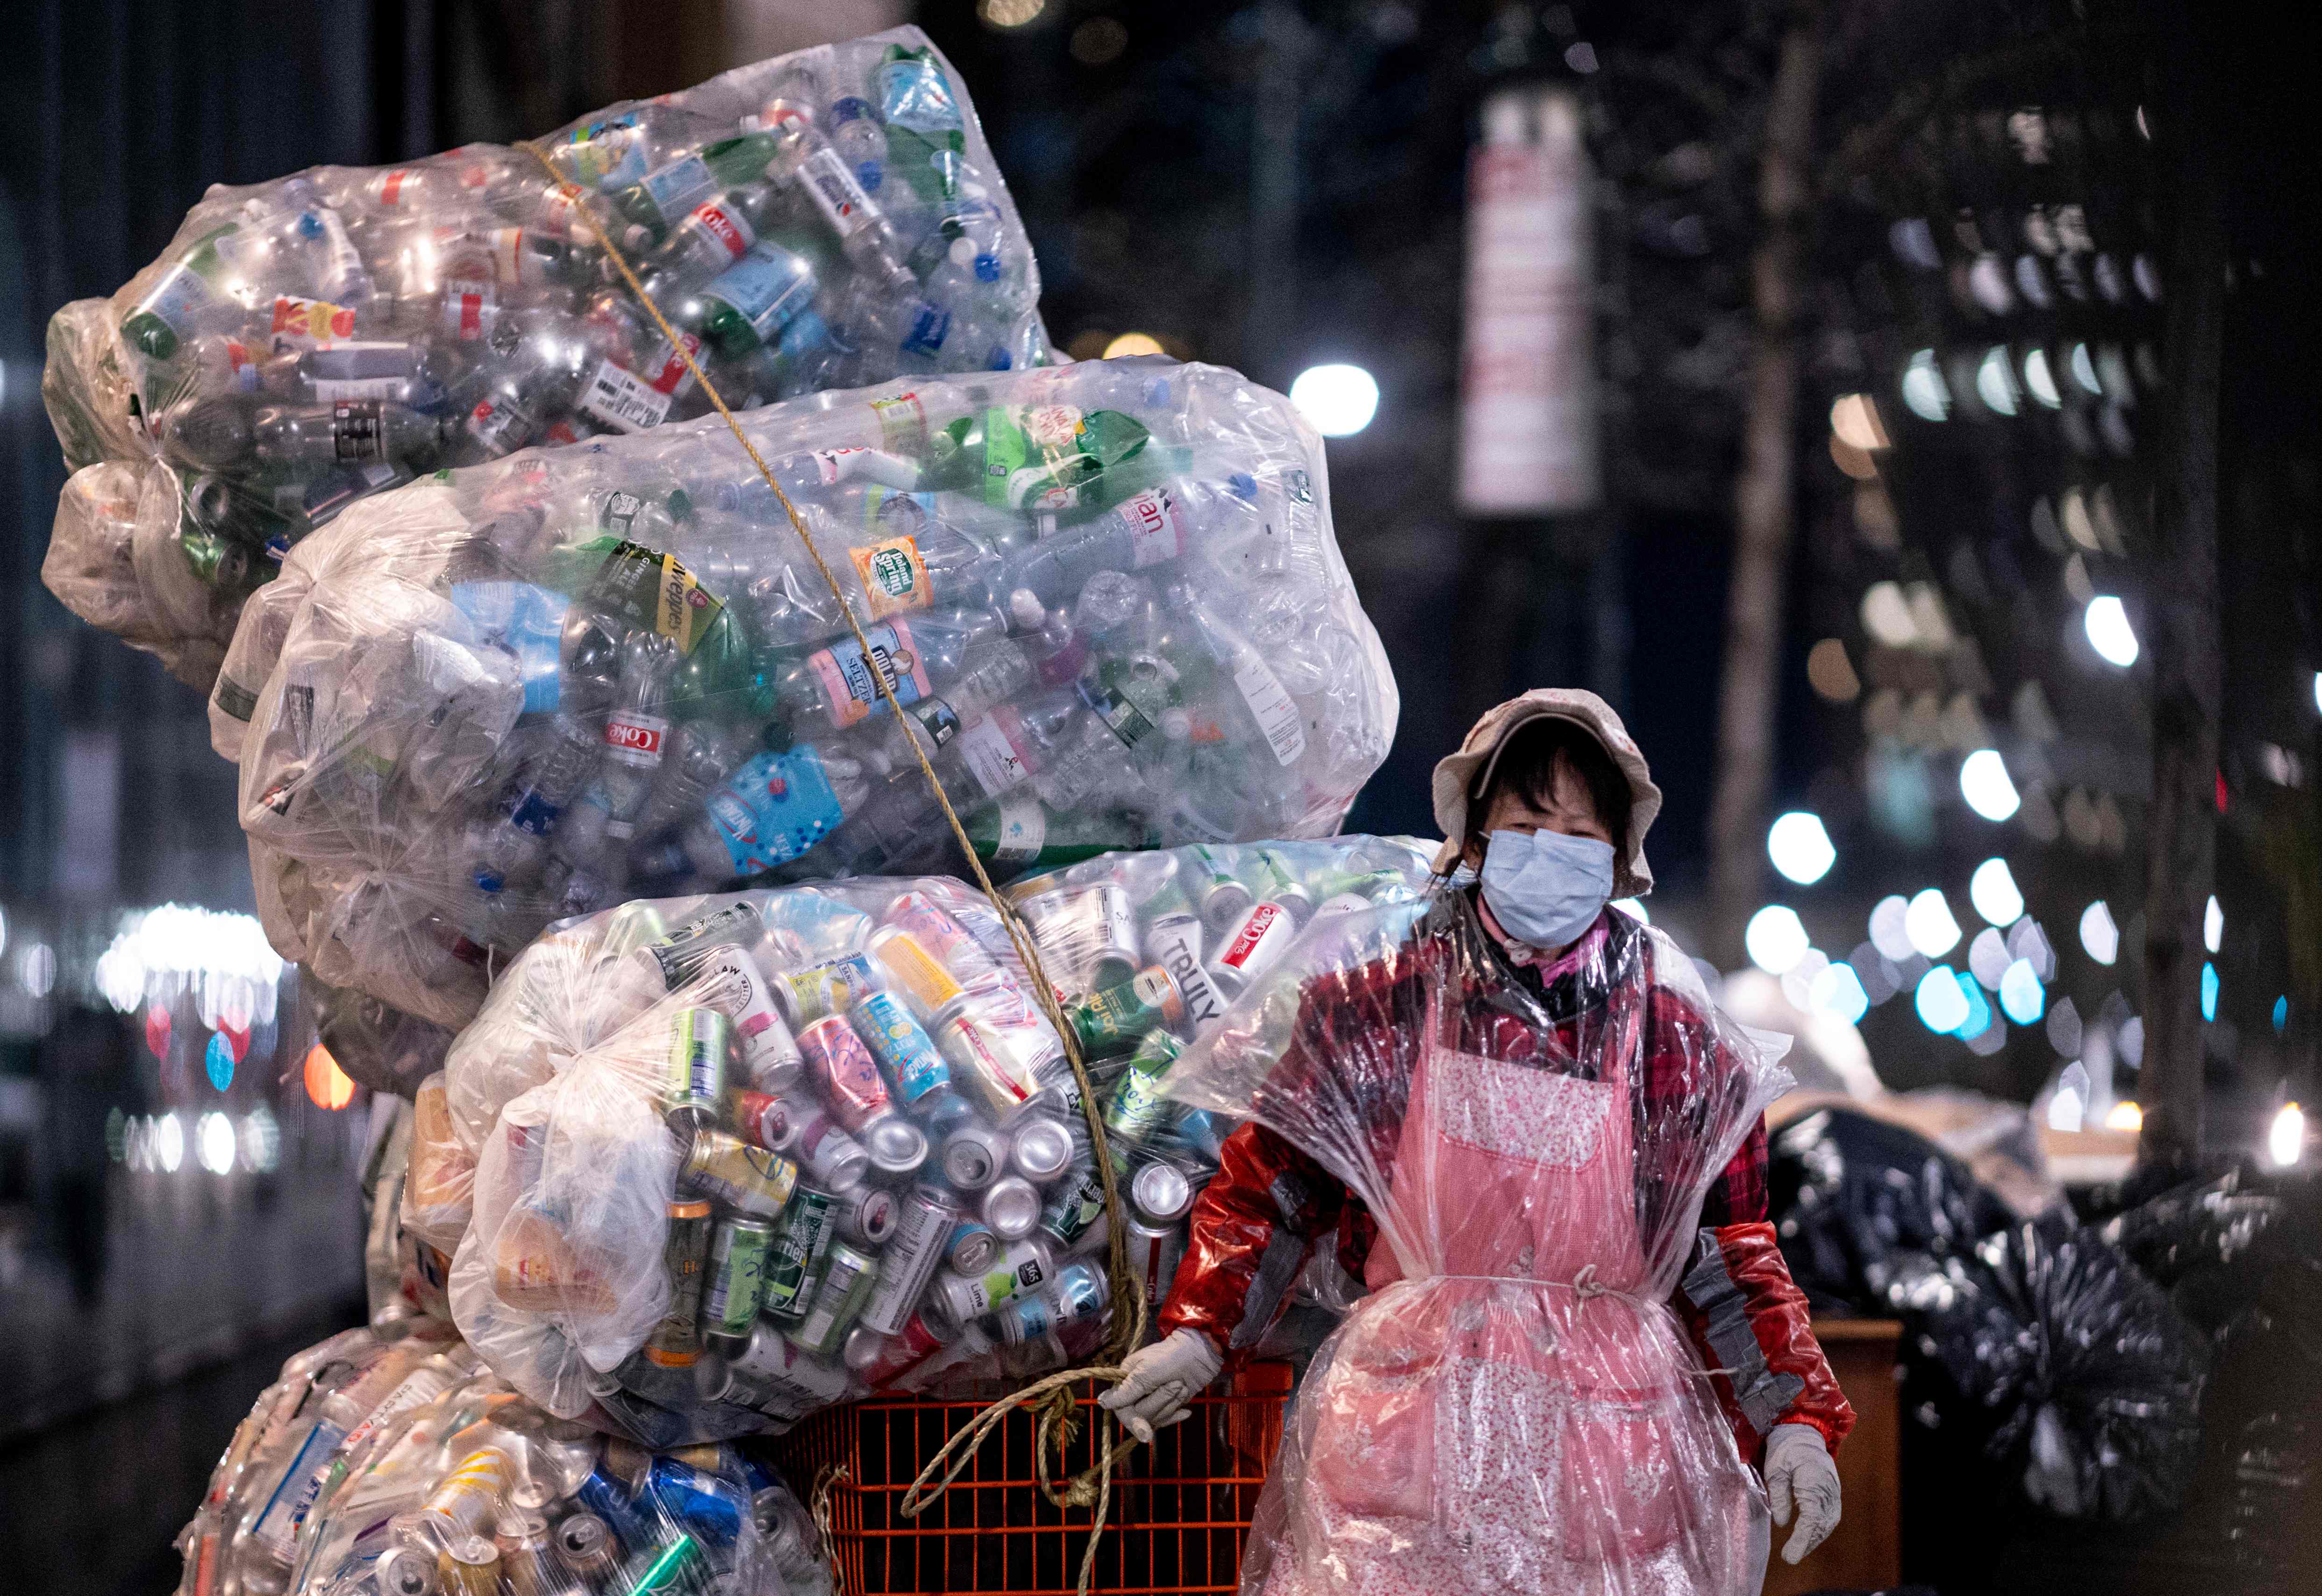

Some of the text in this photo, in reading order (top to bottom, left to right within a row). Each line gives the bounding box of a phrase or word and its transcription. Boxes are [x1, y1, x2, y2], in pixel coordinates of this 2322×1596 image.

[875, 552, 904, 595] Spring
[891, 551, 913, 585] Poland
[846, 657, 873, 706] SELTZER
[608, 724, 653, 749] Coke
[1242, 908, 1275, 941] Coke
[1163, 938, 1221, 1023] TRULY
[1024, 1263, 1039, 1283] 365
[971, 1283, 984, 1308] Lime
